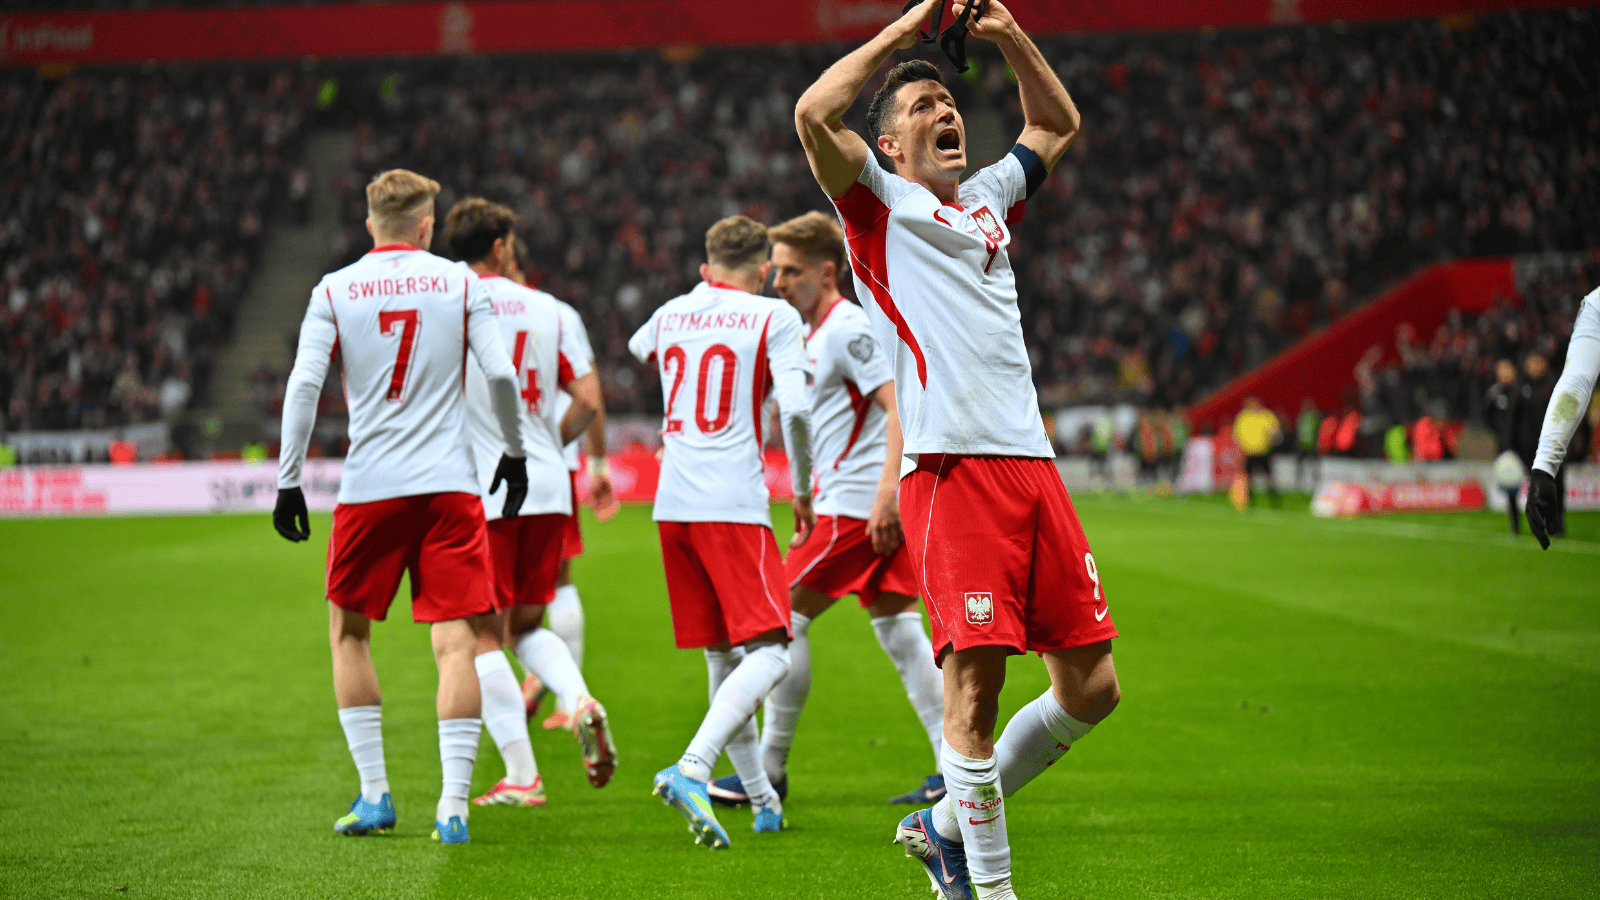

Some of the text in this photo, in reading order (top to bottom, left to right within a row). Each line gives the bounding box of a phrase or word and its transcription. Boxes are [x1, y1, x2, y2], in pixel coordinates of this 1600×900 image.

[348, 275, 449, 301] ŚWIDERSKI
[378, 309, 422, 403] 7
[512, 330, 543, 416] 4
[662, 343, 738, 436] 20
[1084, 552, 1101, 600] 9
[958, 796, 1003, 810] POLSKA
